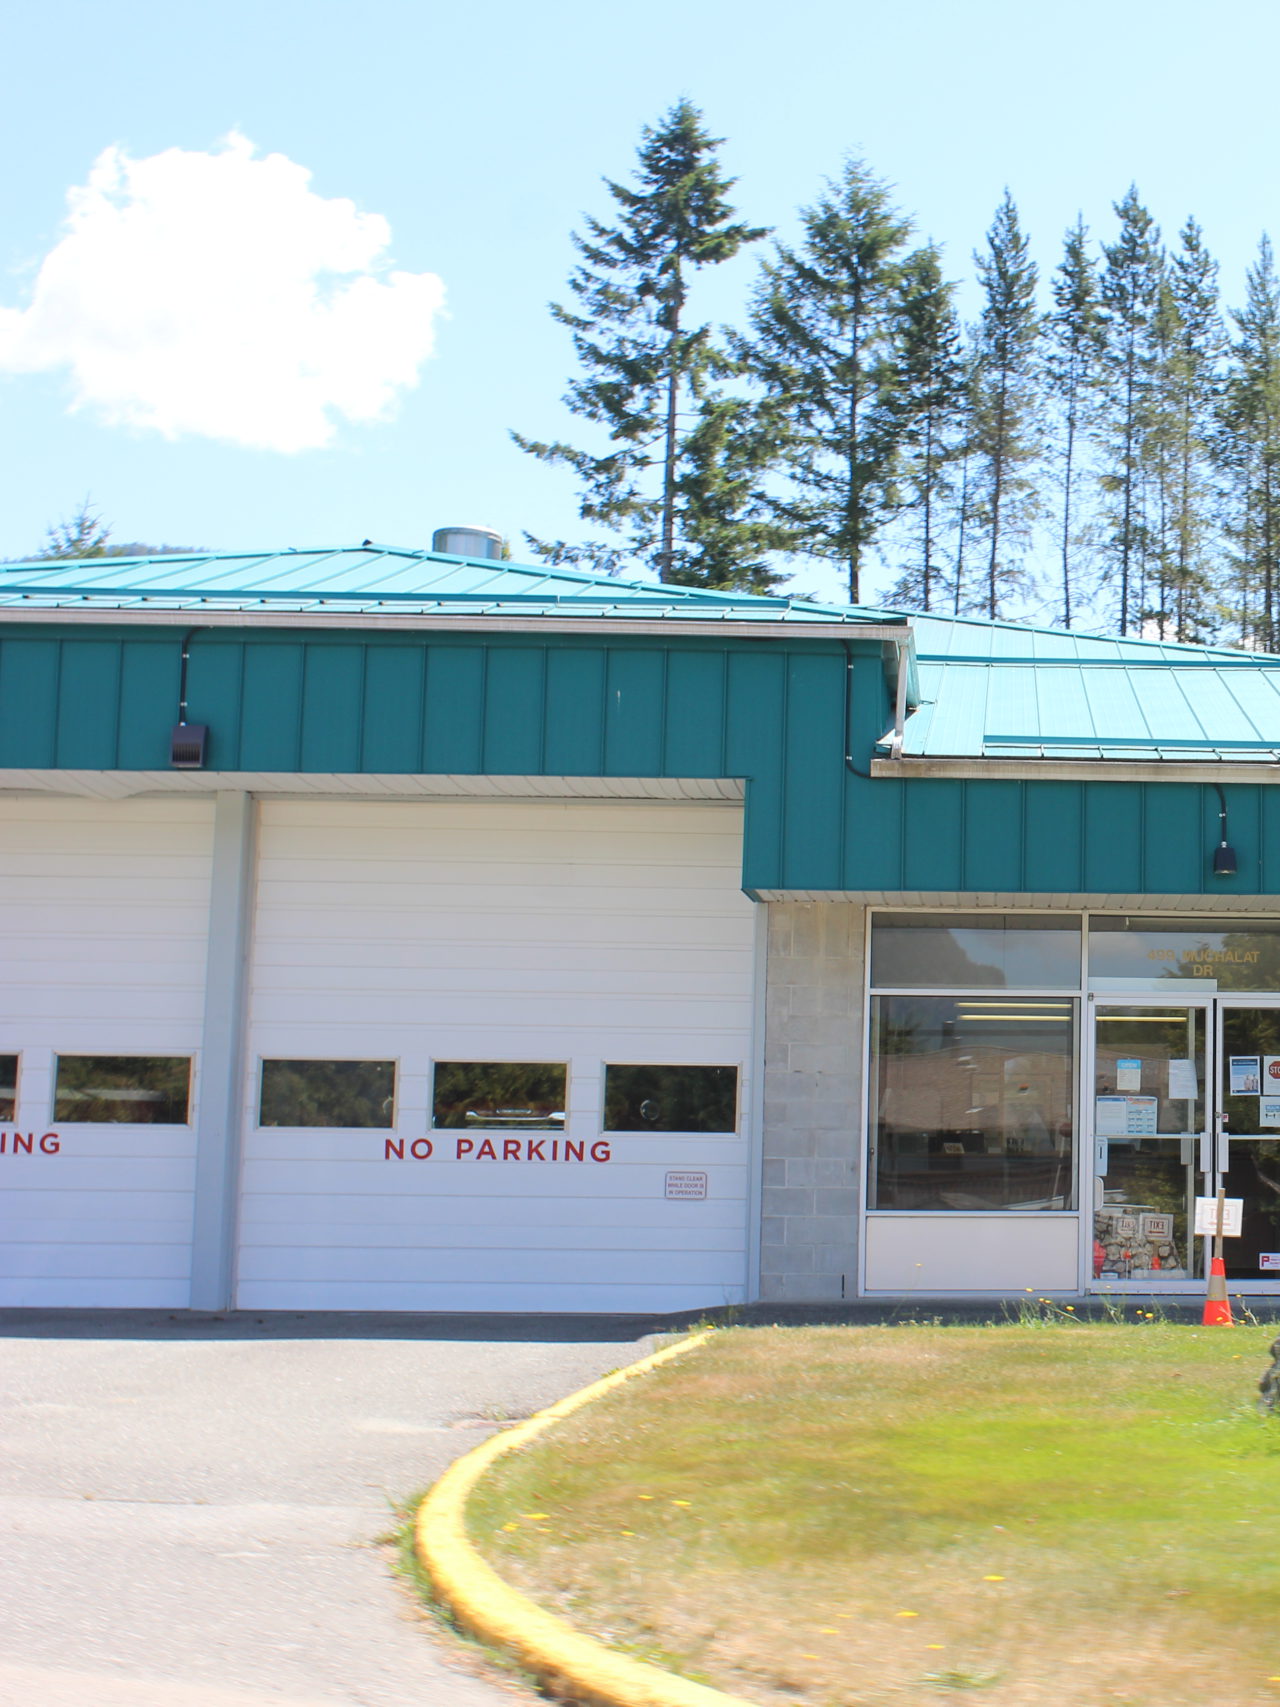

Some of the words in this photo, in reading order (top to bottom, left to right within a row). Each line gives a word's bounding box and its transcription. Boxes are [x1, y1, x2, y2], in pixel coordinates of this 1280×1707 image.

[1182, 949, 1260, 963] MUCHALAT
[1193, 964, 1213, 977] DR
[384, 1138, 433, 1160] NO
[456, 1138, 612, 1163] PARKING
